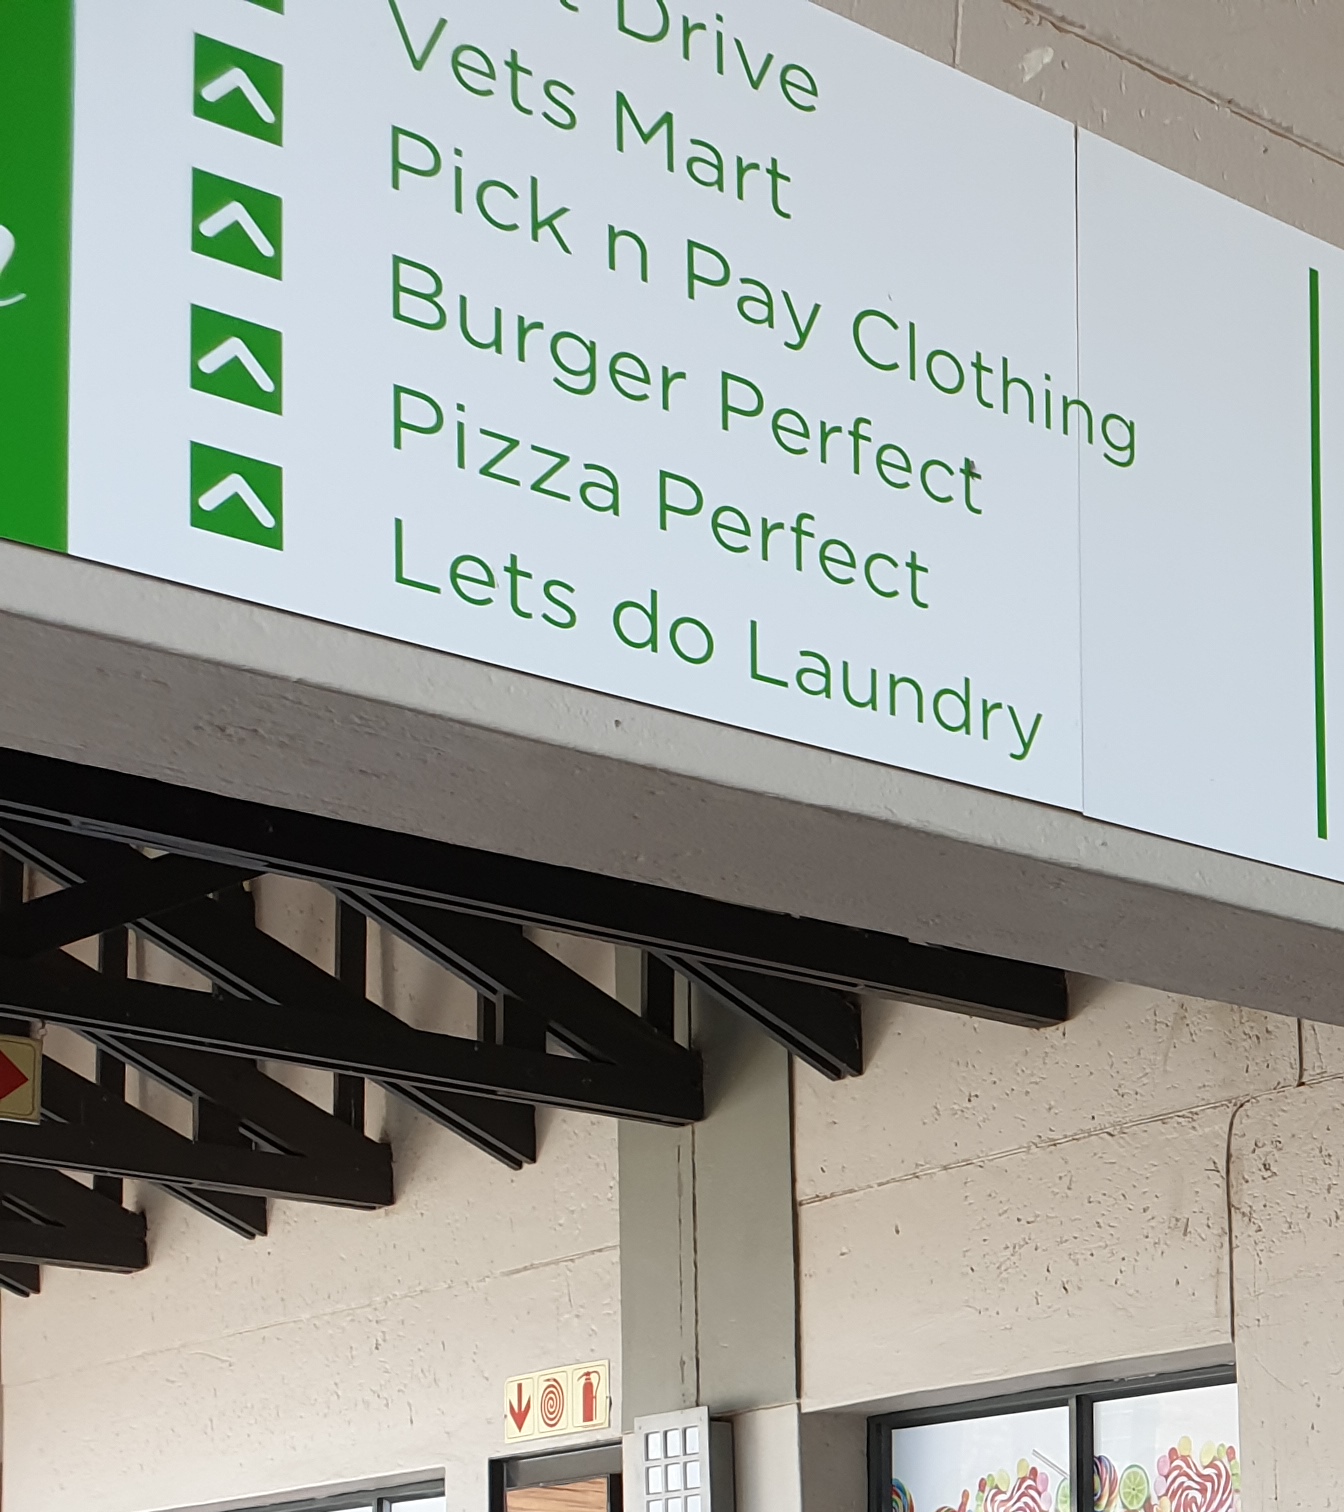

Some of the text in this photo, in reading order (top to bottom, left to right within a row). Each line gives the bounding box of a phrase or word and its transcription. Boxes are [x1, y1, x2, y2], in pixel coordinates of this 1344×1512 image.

[389, 0, 792, 219] Vets Mart
[391, 126, 1137, 469] Pick n Pay Clothing
[391, 255, 983, 516] Burger Perfect
[392, 384, 929, 610] Pizza Perfect
[394, 518, 1043, 762] Lets do Laundry
